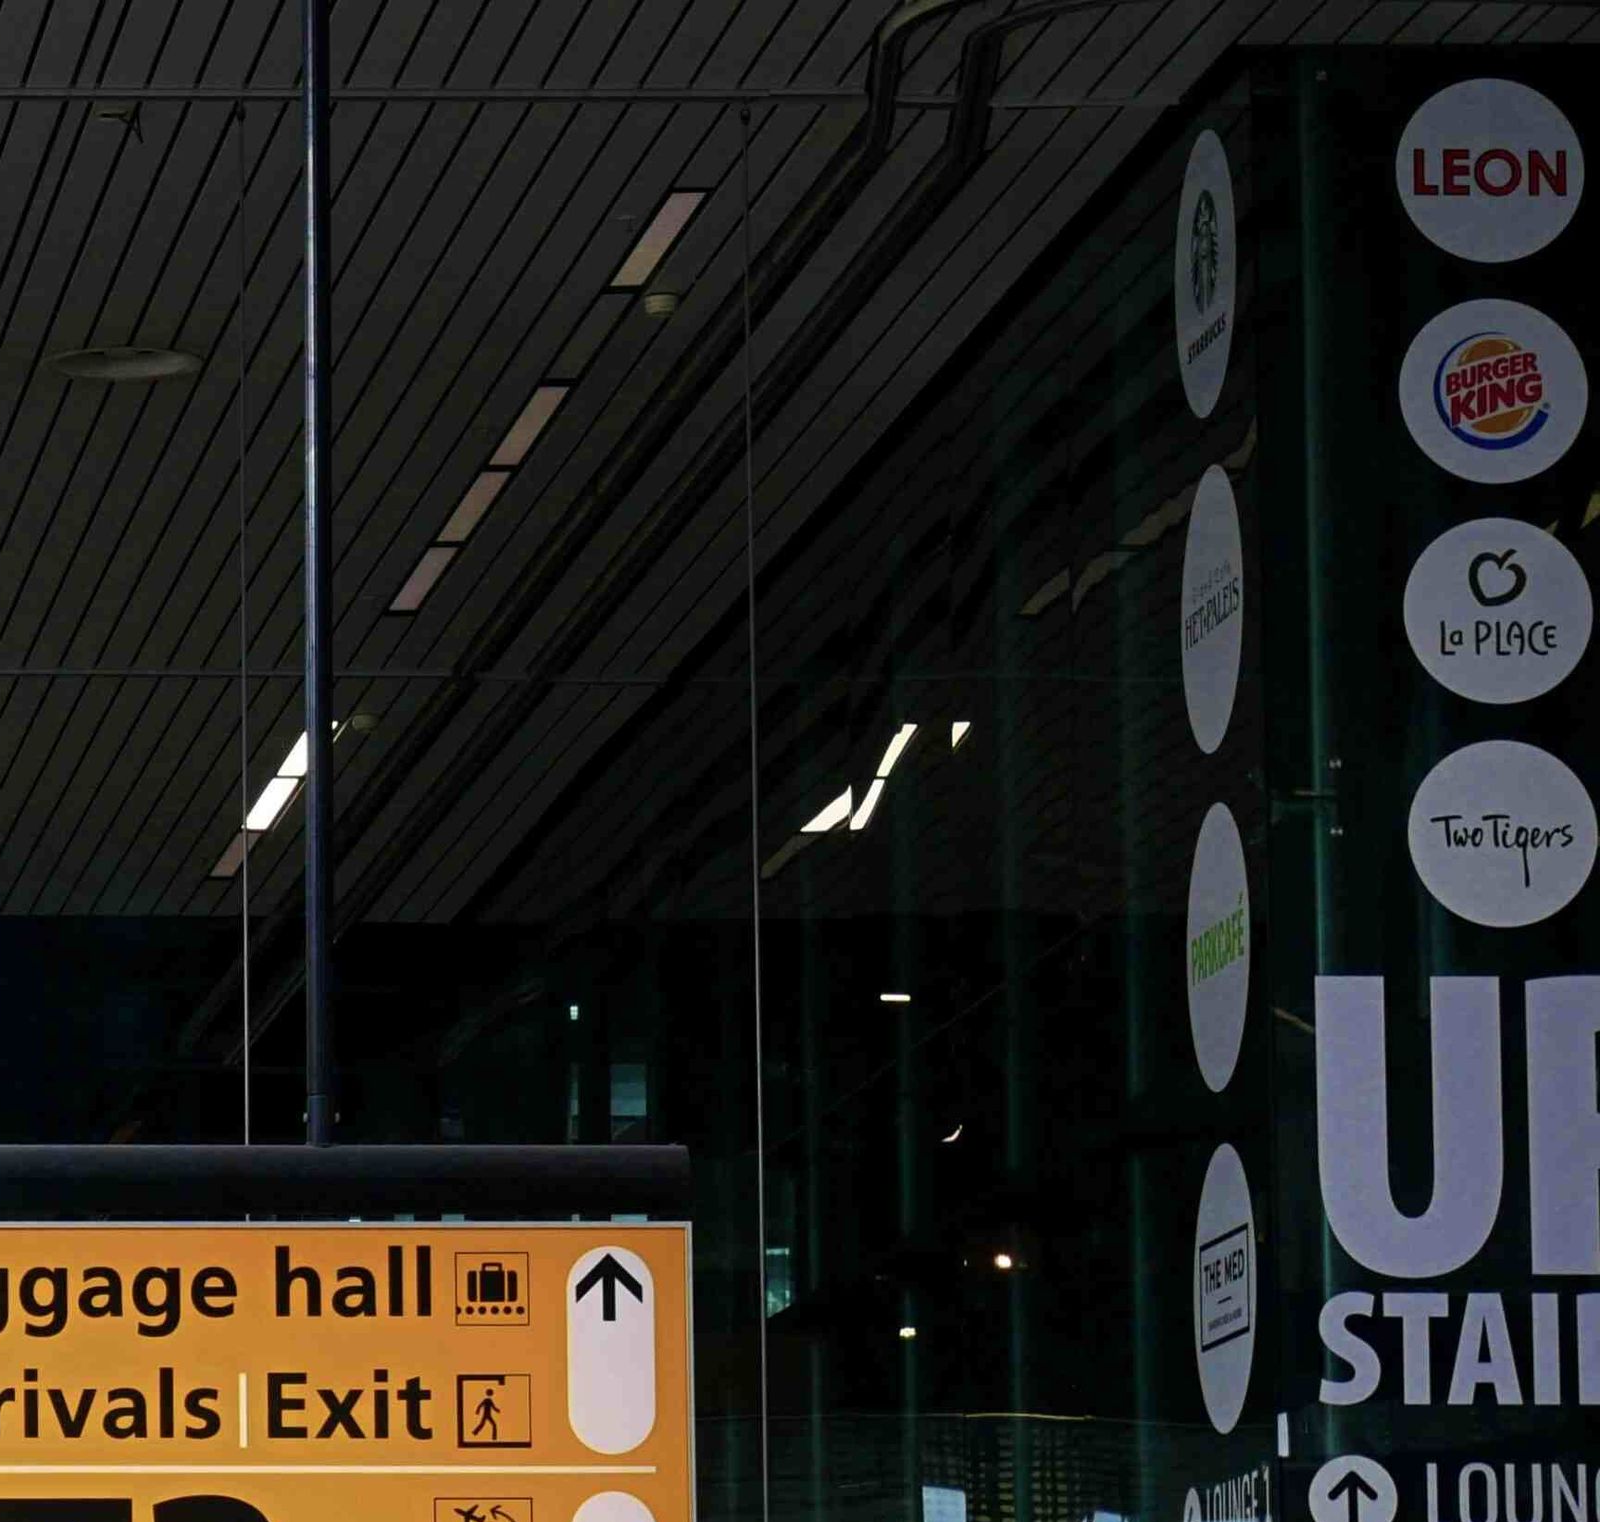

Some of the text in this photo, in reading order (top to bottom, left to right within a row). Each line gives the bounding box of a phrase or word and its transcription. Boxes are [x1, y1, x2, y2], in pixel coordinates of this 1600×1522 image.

[1413, 148, 1568, 198] LEON
[1187, 312, 1227, 365] STARBUCKS
[1445, 351, 1538, 397] BURGER
[1449, 375, 1543, 429] KING
[1475, 620, 1558, 656] PLACE
[274, 1245, 432, 1318] hall
[1203, 1248, 1245, 1295] THE MED
[267, 1368, 433, 1441] Exit
